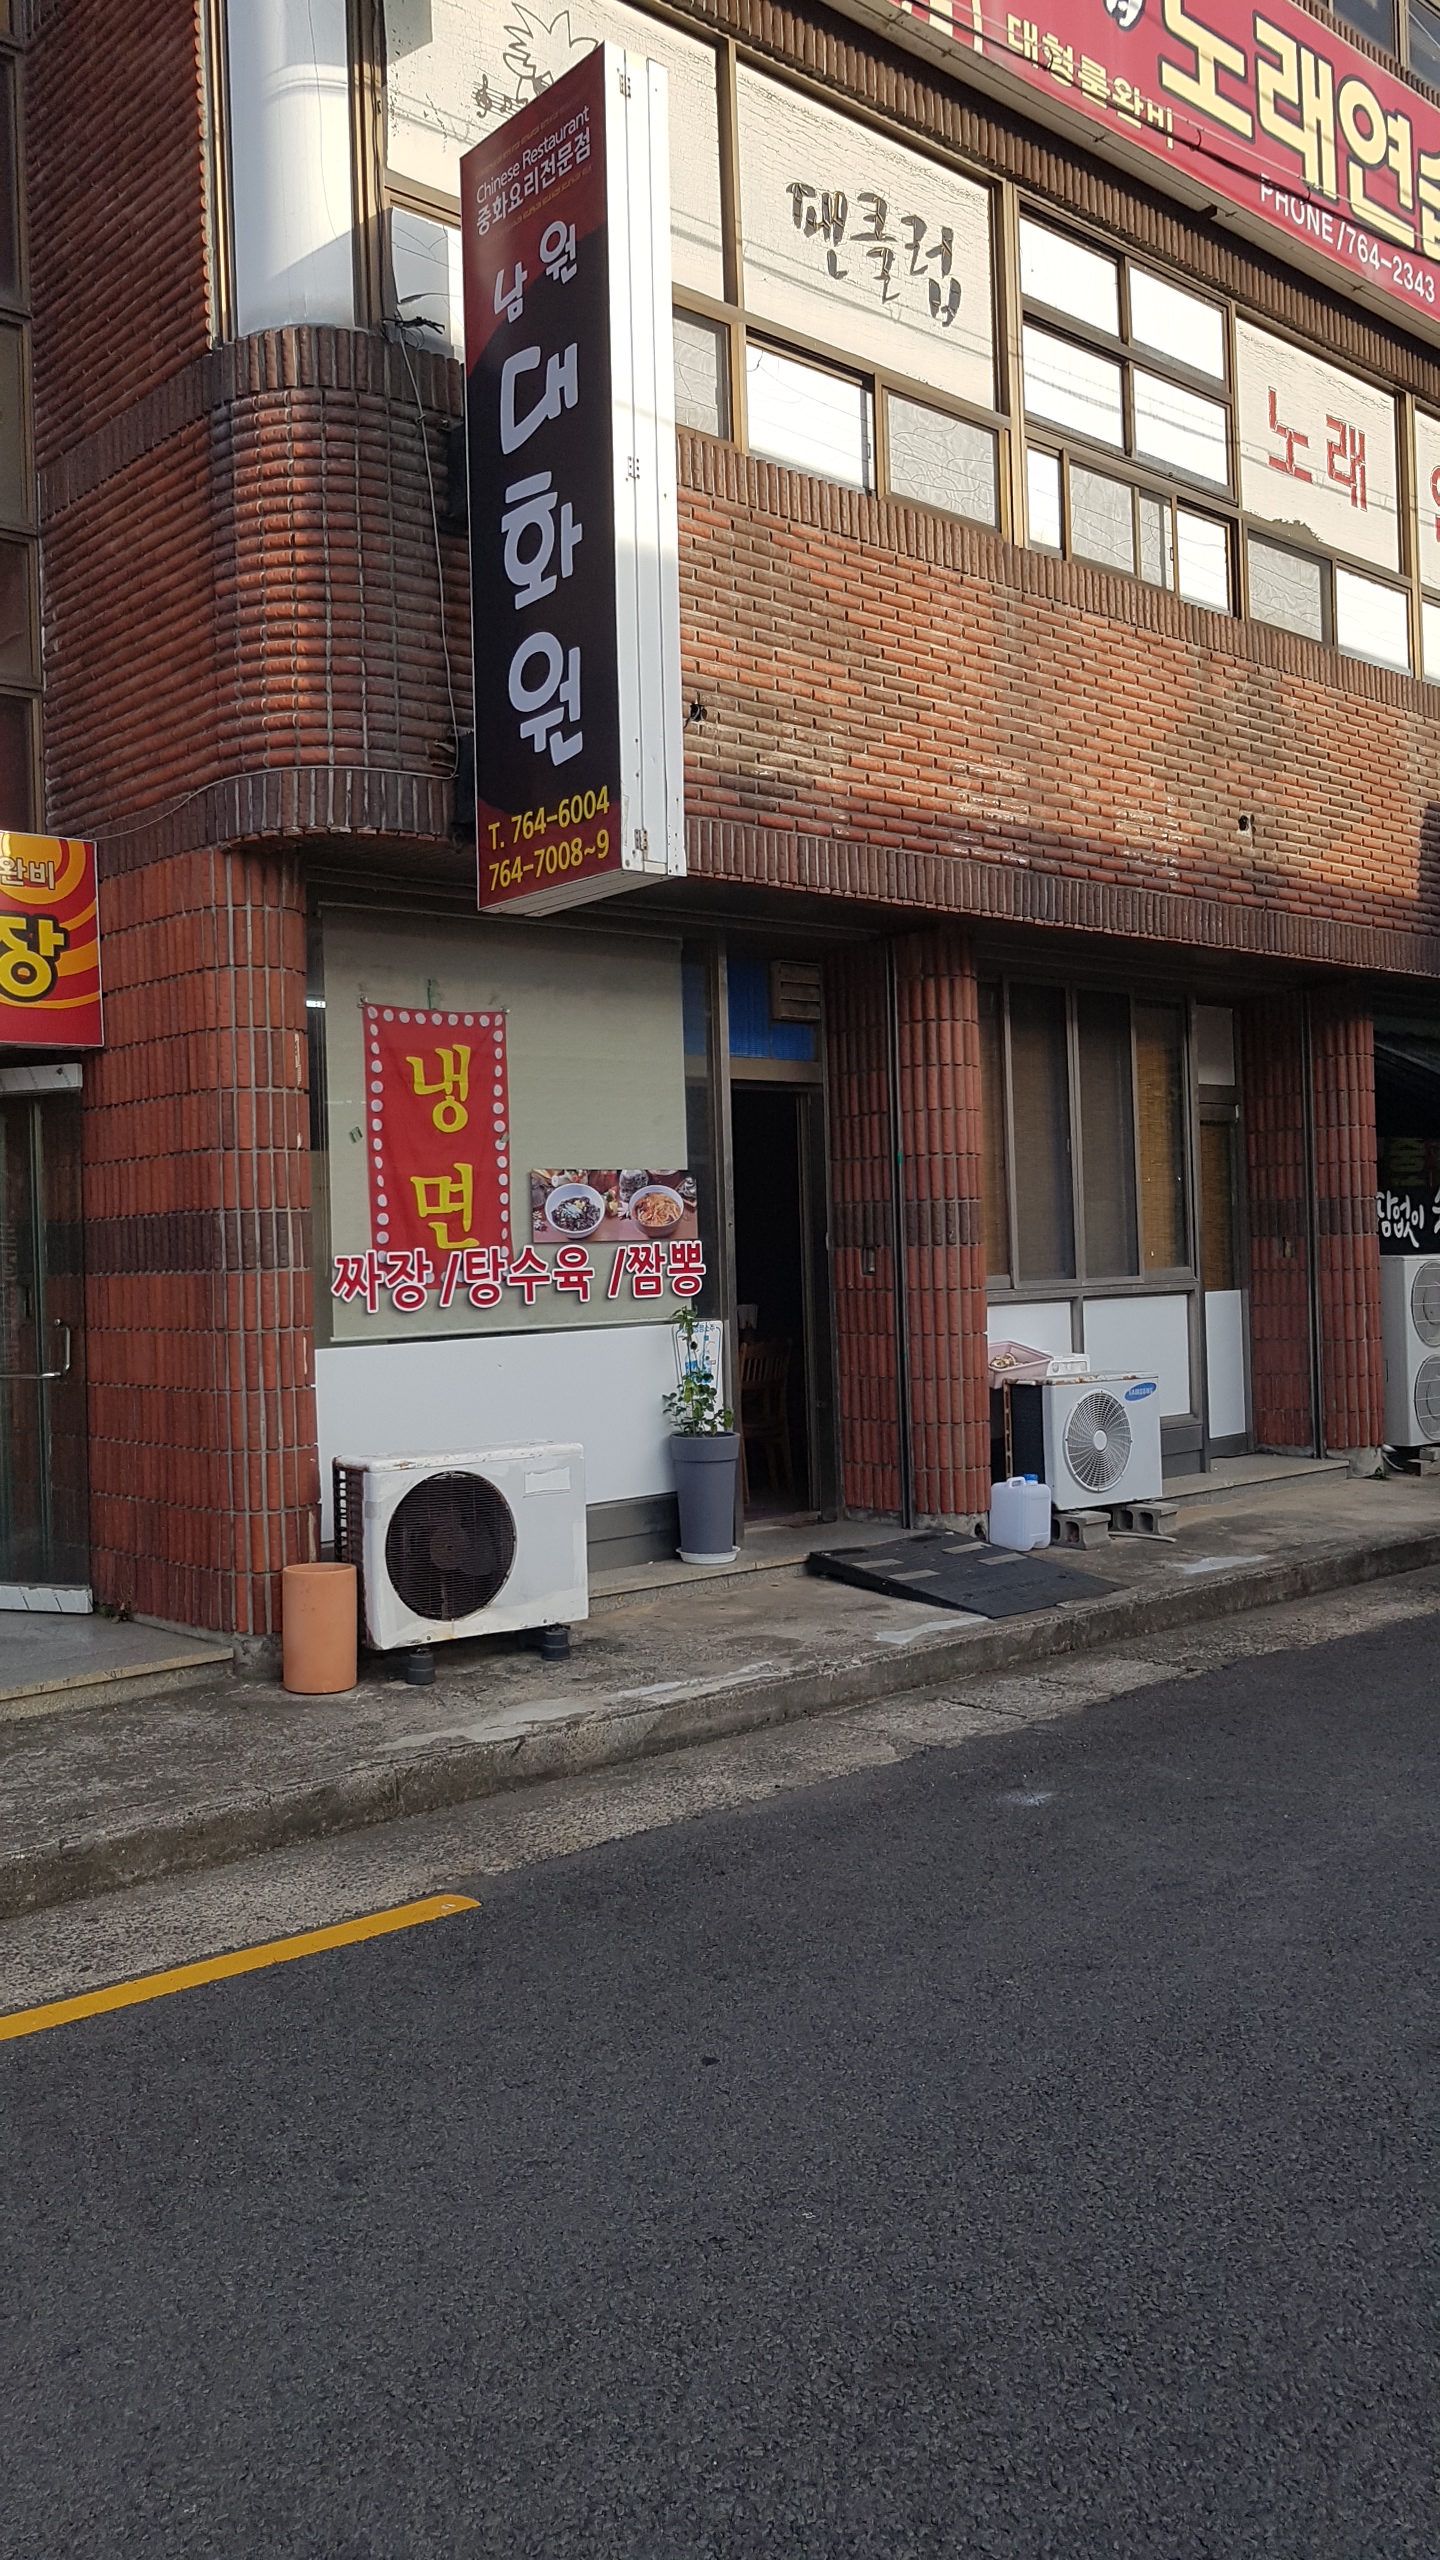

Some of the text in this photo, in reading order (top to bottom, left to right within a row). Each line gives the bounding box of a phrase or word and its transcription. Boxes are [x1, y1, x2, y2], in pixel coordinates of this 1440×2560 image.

[476, 105, 590, 204] Chinese Restaurant
[476, 126, 591, 236] 중화요리전문점
[1160, 0, 1440, 265] 노래연
[500, 341, 584, 767] 대화원
[487, 784, 610, 850] T. 764-6004
[488, 828, 610, 891] 764-7008~9
[405, 1043, 480, 1251] 냉면
